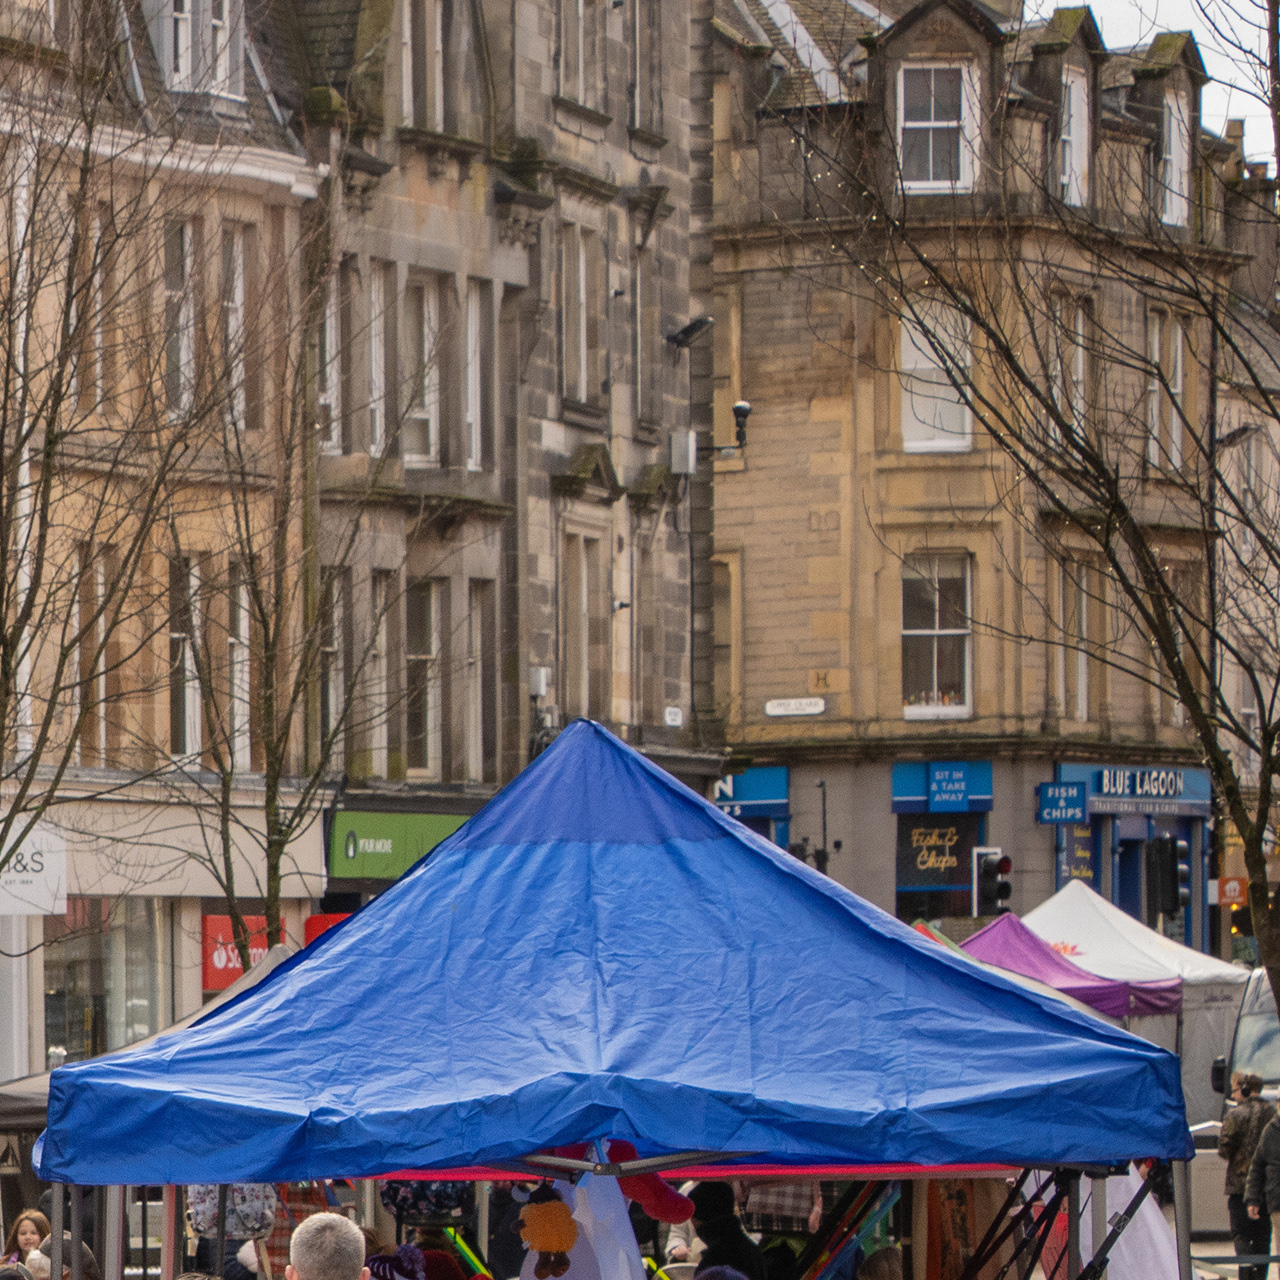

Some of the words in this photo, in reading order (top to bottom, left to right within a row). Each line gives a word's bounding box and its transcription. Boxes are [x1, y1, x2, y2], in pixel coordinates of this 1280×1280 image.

[935, 771, 949, 780] SIT
[953, 771, 963, 780] IN
[942, 781, 966, 791] TAKE
[1103, 769, 1130, 795] BLUE
[1137, 770, 1185, 796] LAGOON
[934, 792, 964, 802] AWAY
[1048, 787, 1078, 798] FISH
[1058, 798, 1066, 808] &
[1043, 808, 1082, 820] CHIPS
[911, 827, 943, 847] Fish
[917, 850, 958, 871] Chips
